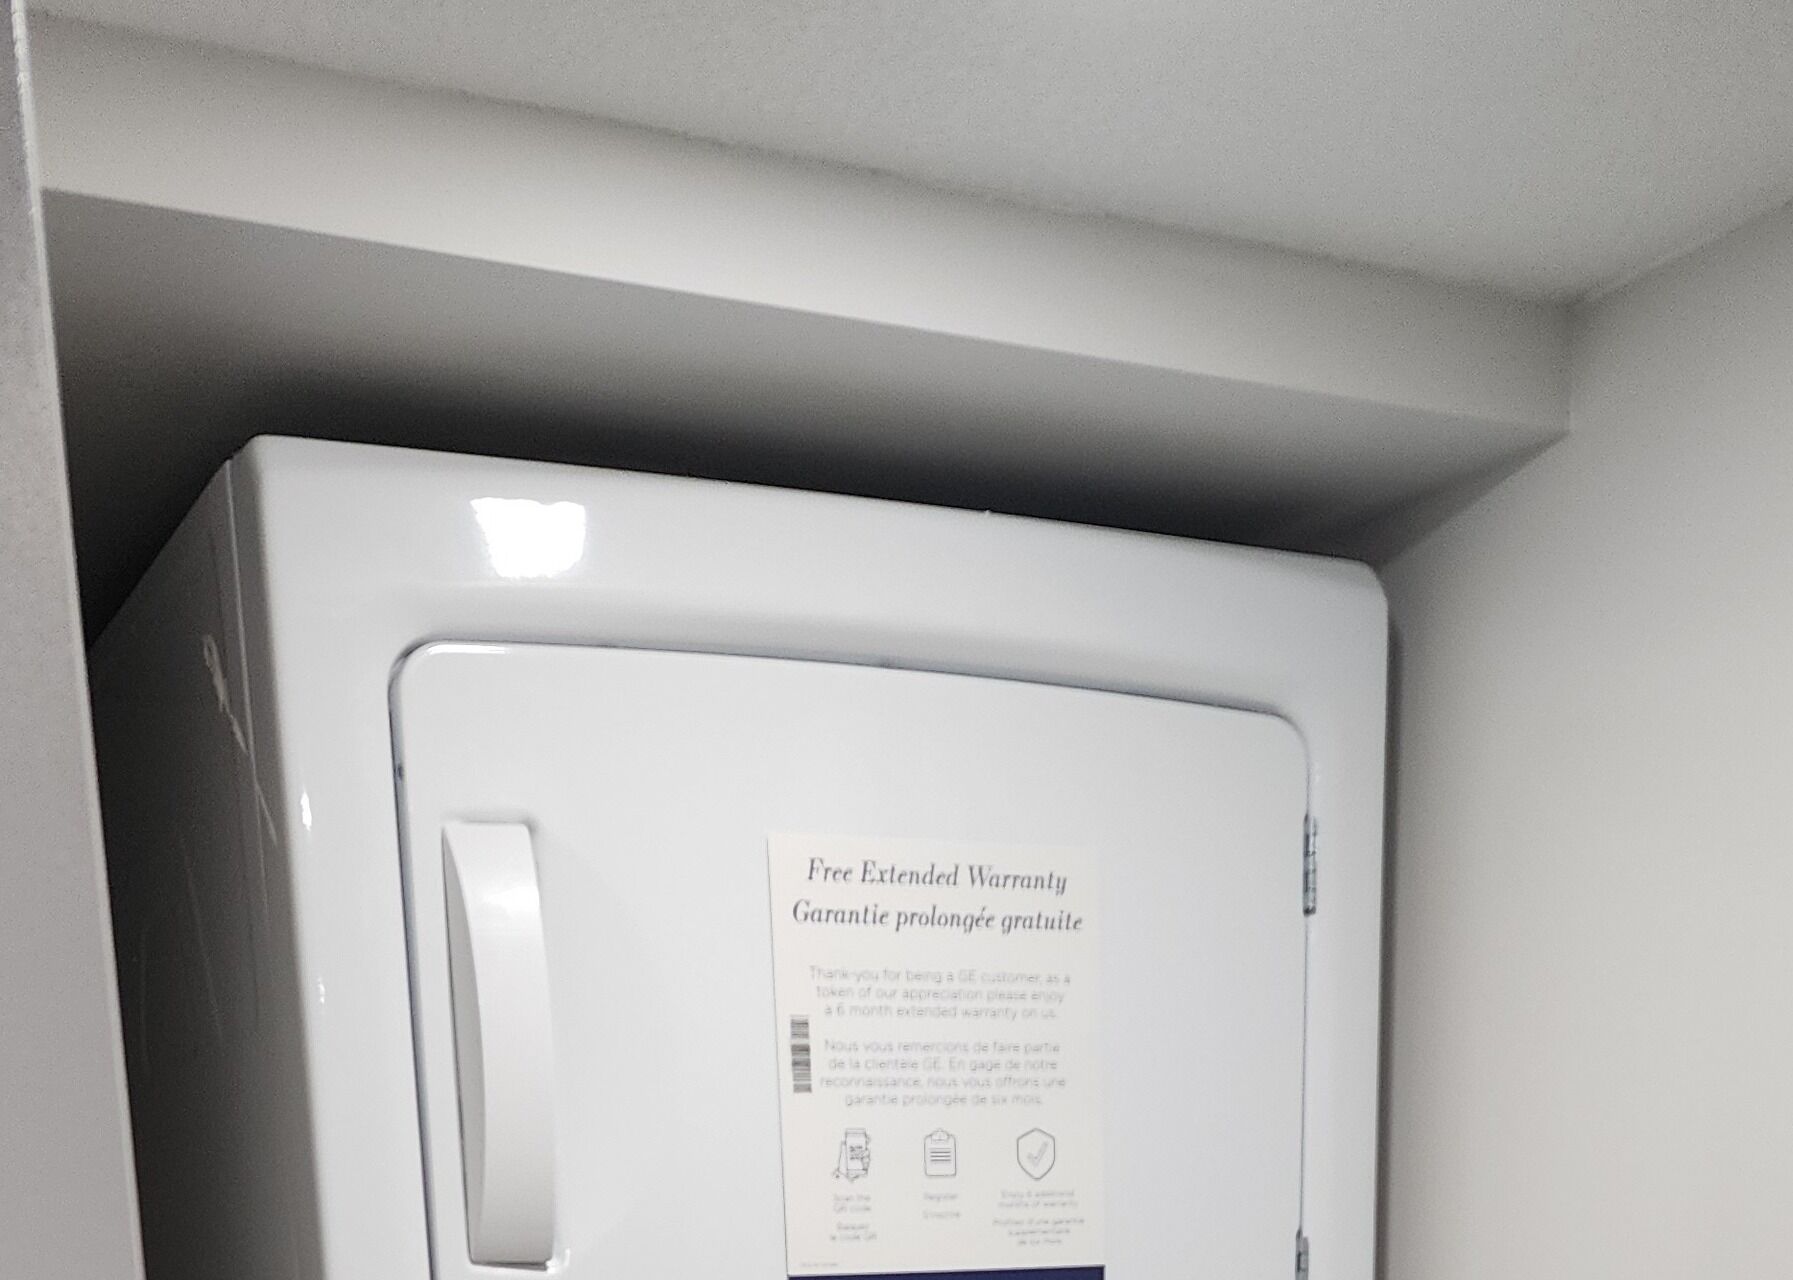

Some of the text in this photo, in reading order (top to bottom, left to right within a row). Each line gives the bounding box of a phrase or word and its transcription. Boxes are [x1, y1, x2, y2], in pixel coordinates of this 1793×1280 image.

[807, 857, 1068, 896] Free Extended Warranty
[791, 898, 1084, 935] Garantie prolongée gratuite
